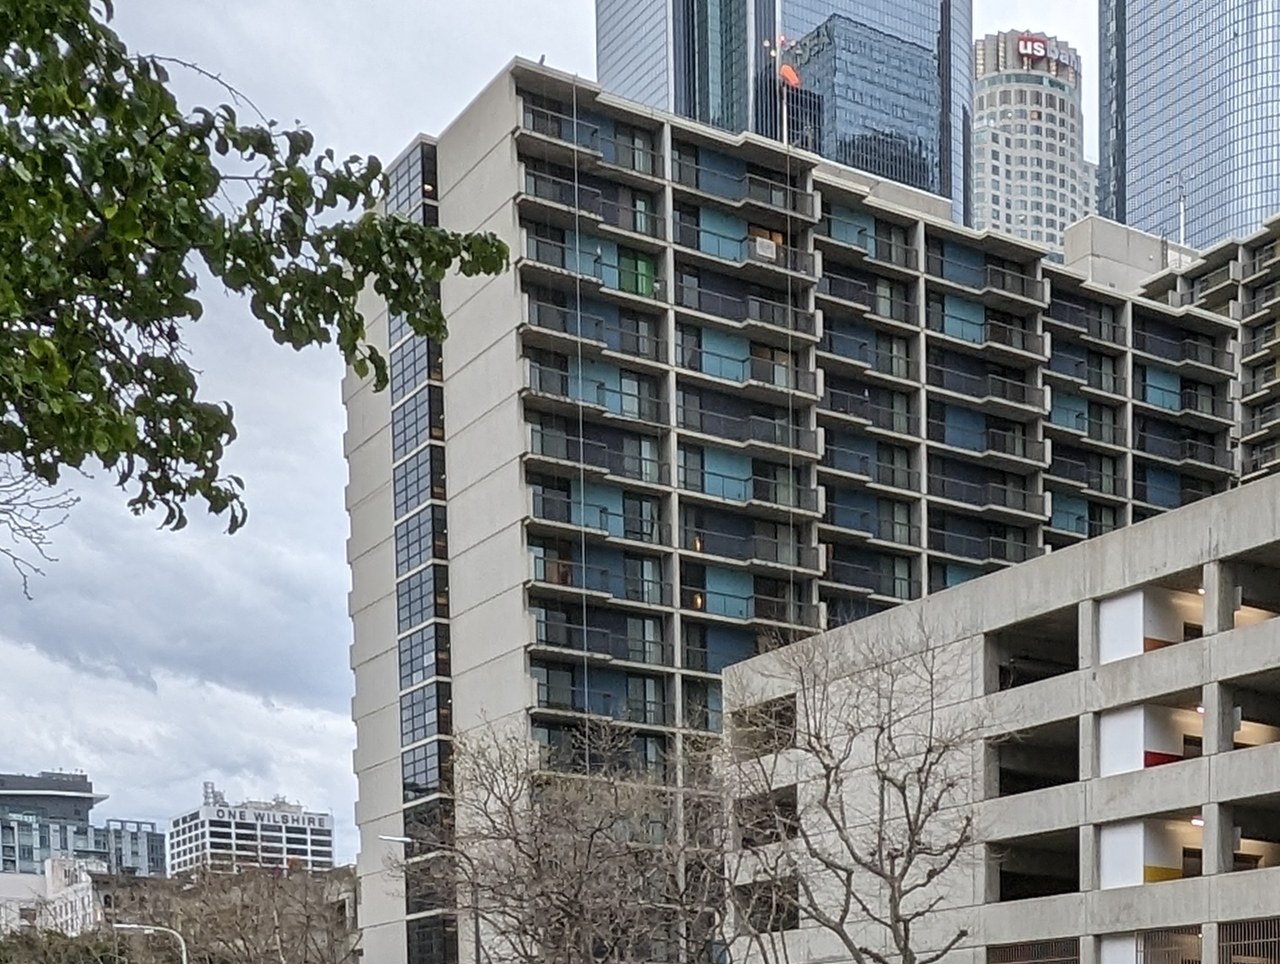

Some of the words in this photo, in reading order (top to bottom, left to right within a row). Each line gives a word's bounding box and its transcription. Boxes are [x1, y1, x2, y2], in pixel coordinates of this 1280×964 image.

[1018, 40, 1046, 57] us
[216, 804, 246, 820] ONE
[253, 811, 325, 828] WILSHIRE
